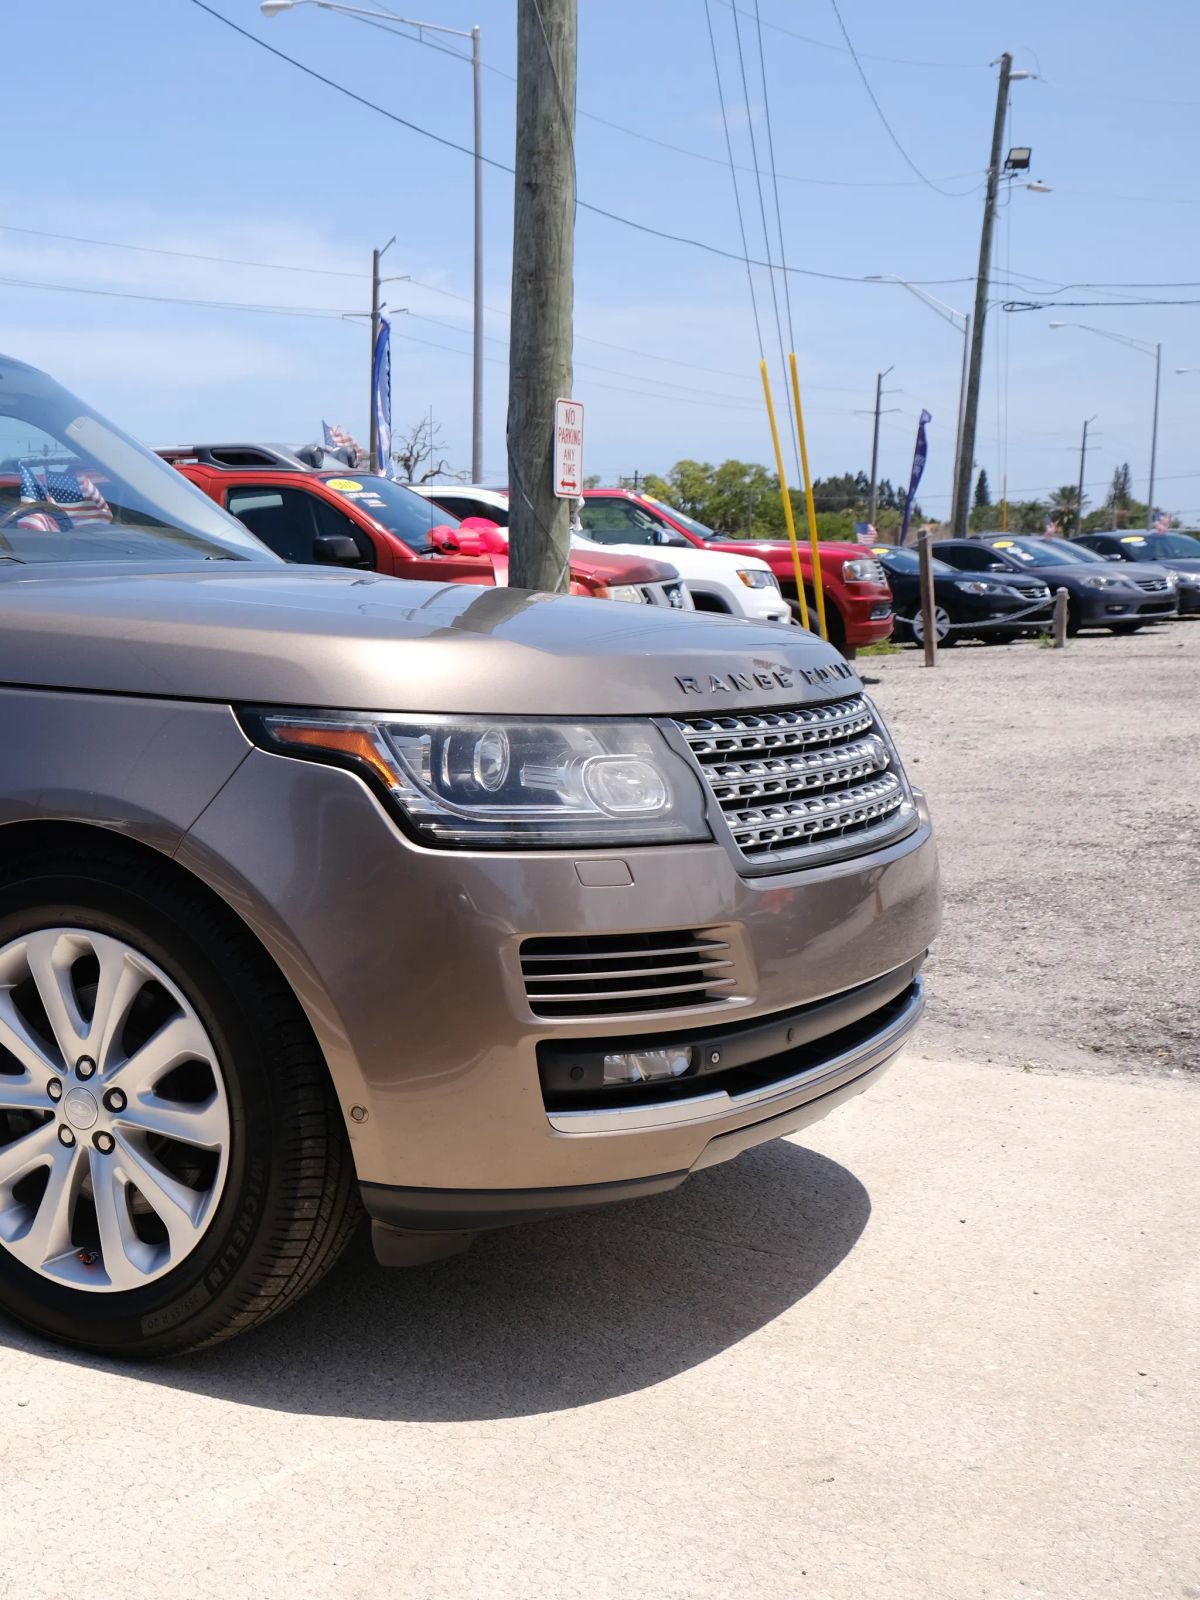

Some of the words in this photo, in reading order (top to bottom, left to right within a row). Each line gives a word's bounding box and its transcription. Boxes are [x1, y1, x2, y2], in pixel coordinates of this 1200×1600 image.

[565, 408, 576, 426] NO
[558, 427, 581, 446] PARKING
[564, 448, 576, 461] ANY
[563, 462, 576, 477] TIME
[674, 670, 794, 695] RANGE
[208, 1156, 264, 1287] MICHELIN
